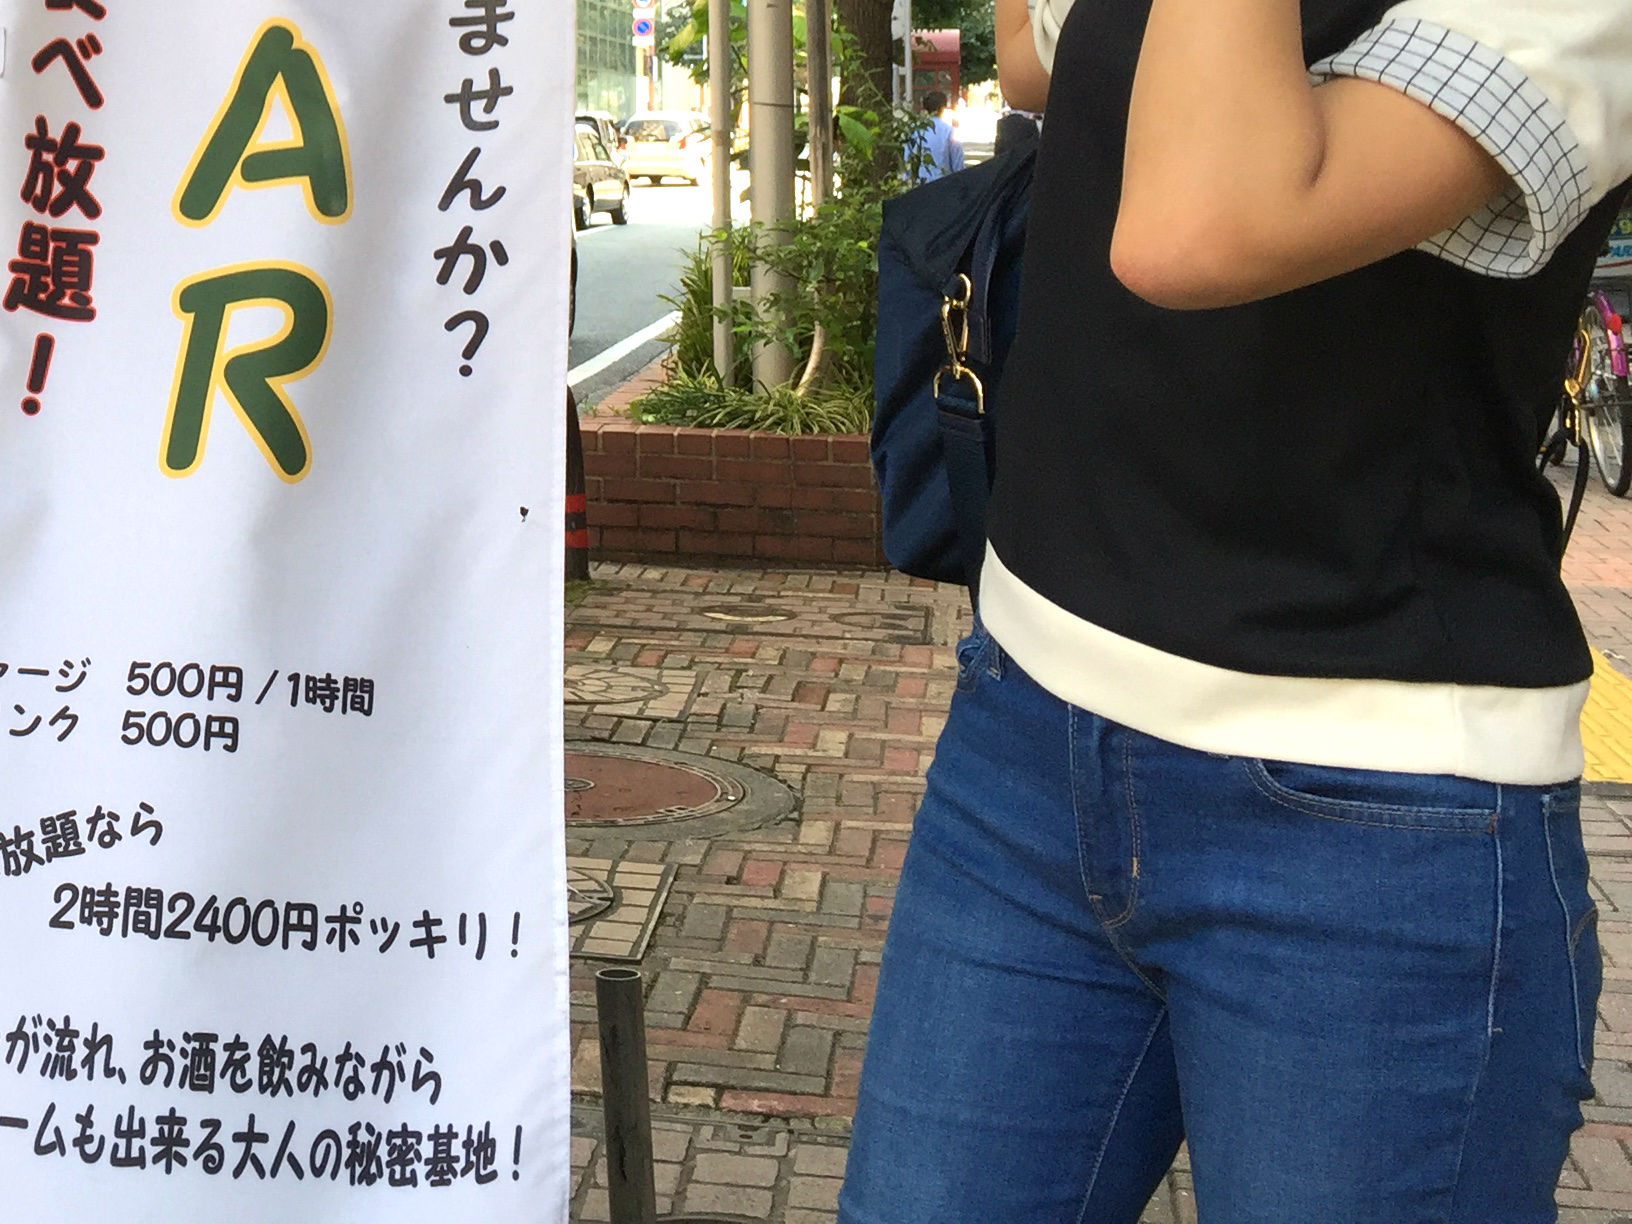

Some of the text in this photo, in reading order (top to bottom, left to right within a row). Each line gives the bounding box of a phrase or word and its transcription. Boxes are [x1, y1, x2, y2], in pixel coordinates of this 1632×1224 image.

[120, 709, 240, 754] 500円
[48, 882, 522, 961] 2時間2400円ポッキリ！
